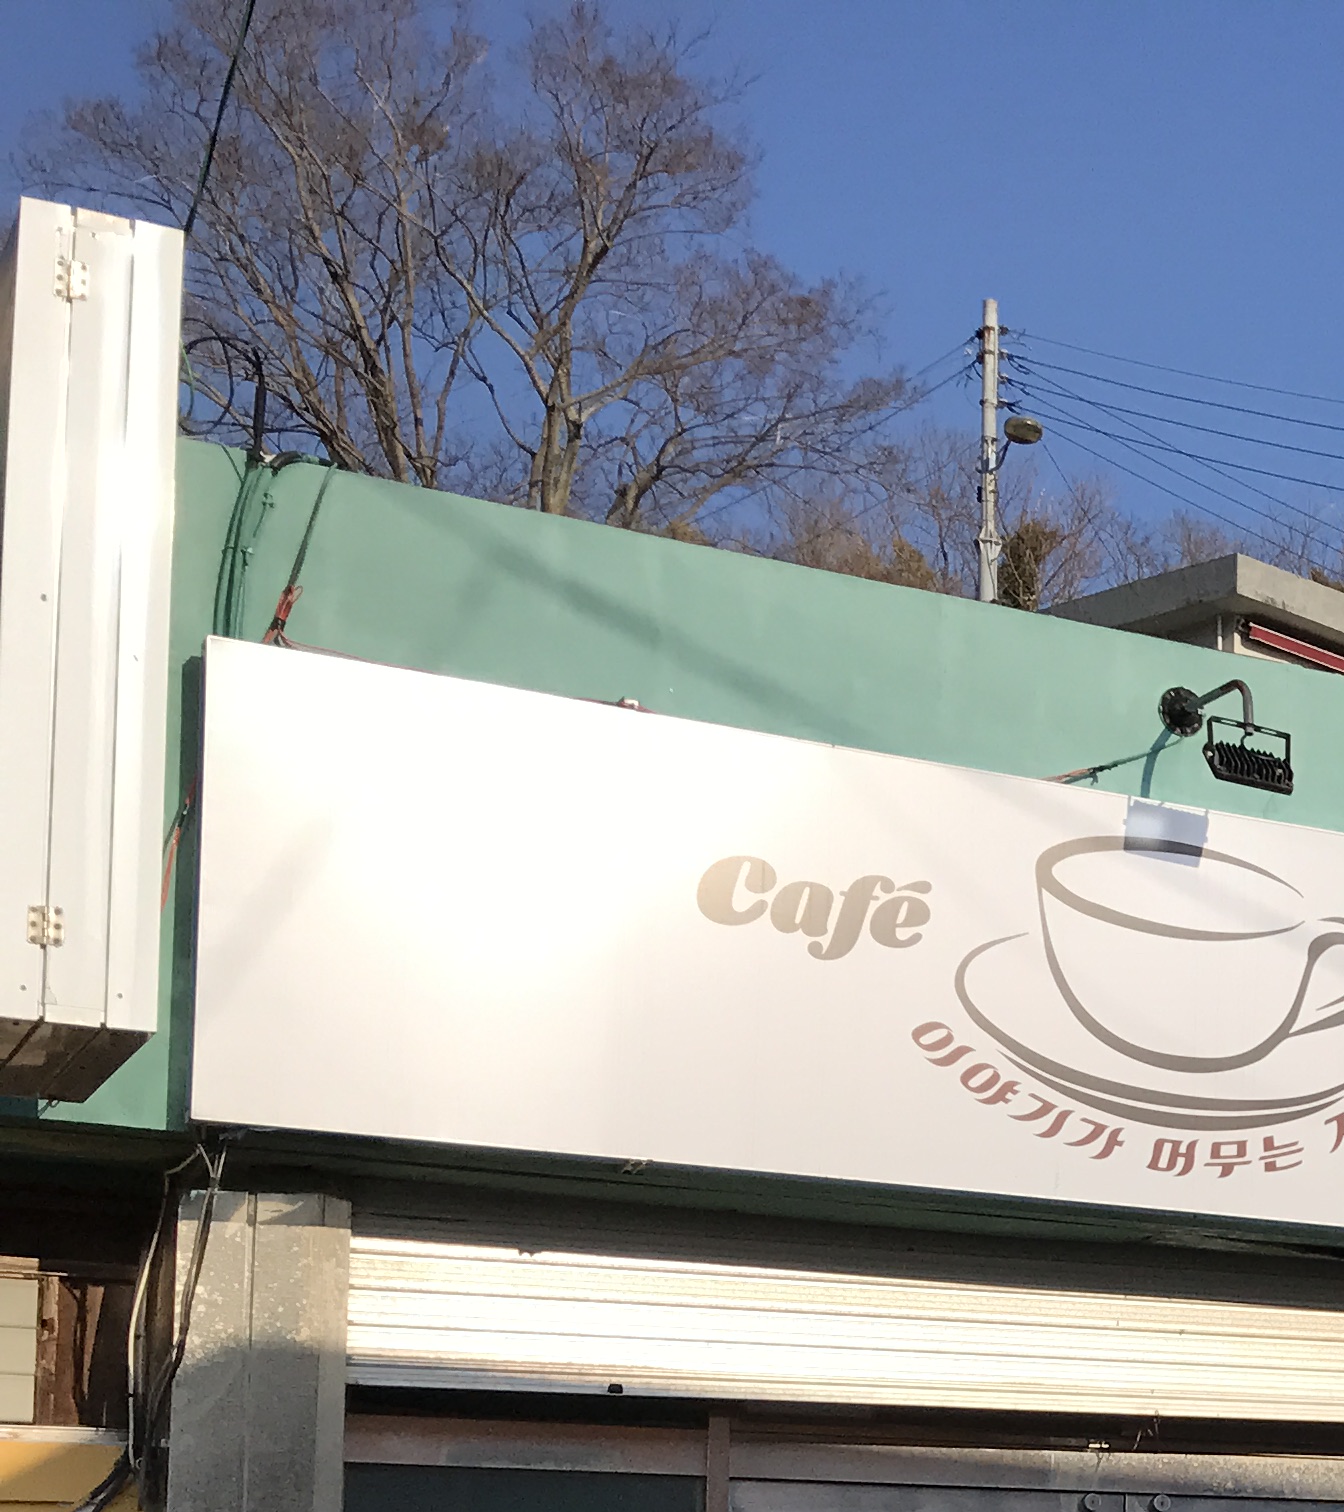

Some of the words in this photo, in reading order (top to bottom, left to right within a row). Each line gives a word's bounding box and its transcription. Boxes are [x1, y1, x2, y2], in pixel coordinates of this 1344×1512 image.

[696, 853, 932, 960] Café
[910, 1020, 1124, 1161] 이야기가
[1146, 1134, 1305, 1178] 머무는
